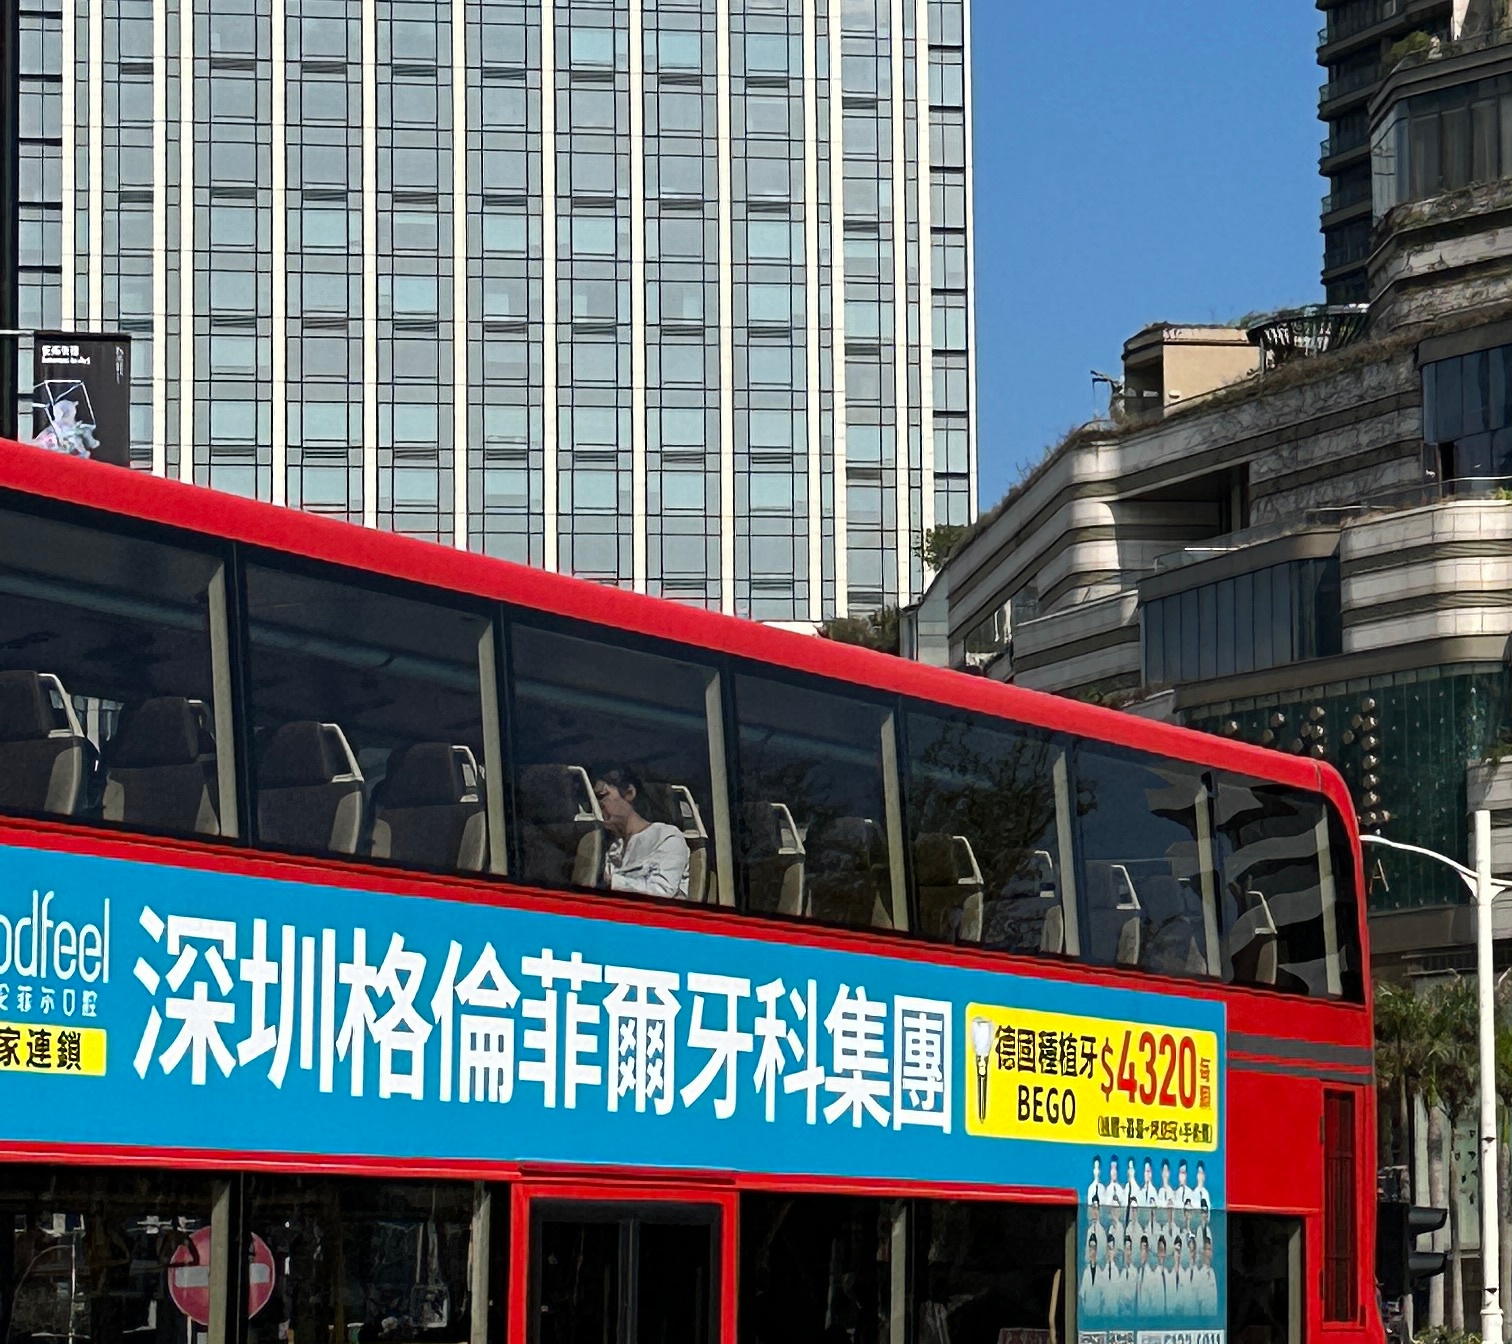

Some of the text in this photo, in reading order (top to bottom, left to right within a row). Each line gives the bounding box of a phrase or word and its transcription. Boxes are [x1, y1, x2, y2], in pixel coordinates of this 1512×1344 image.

[133, 906, 953, 1134] 深圳格倫菲爾牙科集團
[995, 1024, 1098, 1079] 德國種植牙
[1101, 1029, 1197, 1109] $4320
[1017, 1084, 1076, 1126] BEGO
